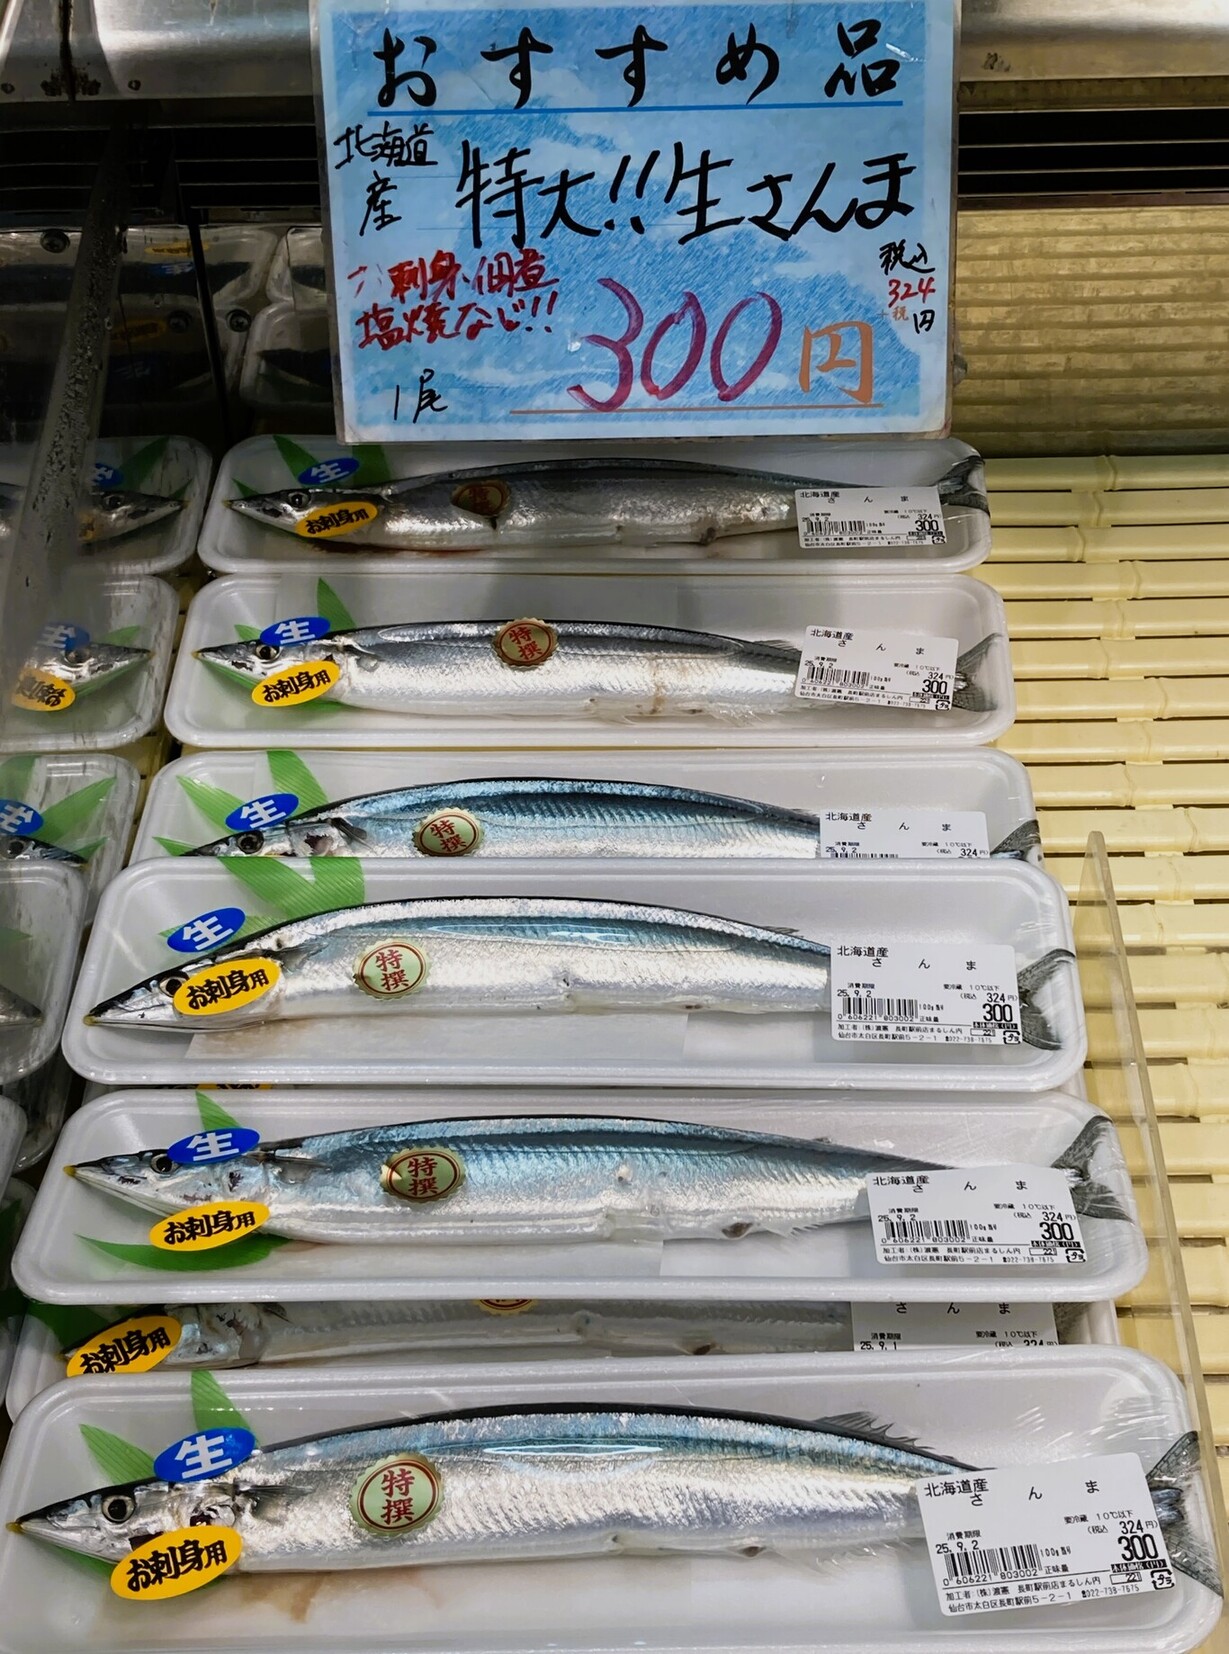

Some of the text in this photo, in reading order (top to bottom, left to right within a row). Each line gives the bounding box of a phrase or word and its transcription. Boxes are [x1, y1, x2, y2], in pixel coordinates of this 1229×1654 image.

[372, 19, 901, 109] おすすめ品
[335, 123, 437, 169] 北海道
[879, 238, 935, 275] 税込
[888, 277, 936, 308] 324
[310, 461, 350, 484] 生
[306, 508, 369, 535] お刺身用
[915, 520, 938, 532] 300
[275, 620, 316, 644] 生
[810, 629, 854, 640] 北海道産
[262, 669, 331, 702] お刺身用
[922, 680, 947, 694] 300
[928, 672, 944, 680] 324
[240, 797, 286, 828] 生
[826, 812, 872, 822] 北海道産
[430, 820, 468, 852] 特撰
[960, 848, 978, 856] 324
[182, 911, 232, 951] 生
[837, 946, 888, 958] 北海道産
[376, 950, 409, 990] 特撰
[186, 968, 268, 1008] お刺身用
[987, 993, 1006, 1002] 324
[982, 1004, 1012, 1022] 300
[187, 1132, 240, 1161] 生
[408, 1158, 438, 1196] 特撰
[873, 1175, 930, 1186] 北海道産
[163, 1210, 256, 1246] お刺身用
[1042, 1212, 1062, 1221] 324
[1039, 1222, 1073, 1240] 300
[80, 1327, 170, 1375] お刺身用
[175, 1433, 232, 1479] 生
[380, 1468, 415, 1524] 特撰
[924, 1479, 988, 1498] 北海道産
[946, 1530, 981, 1541] 消費期限
[1119, 1520, 1144, 1534] 324
[1118, 1534, 1159, 1561] 300
[126, 1540, 228, 1592] お刺身用
